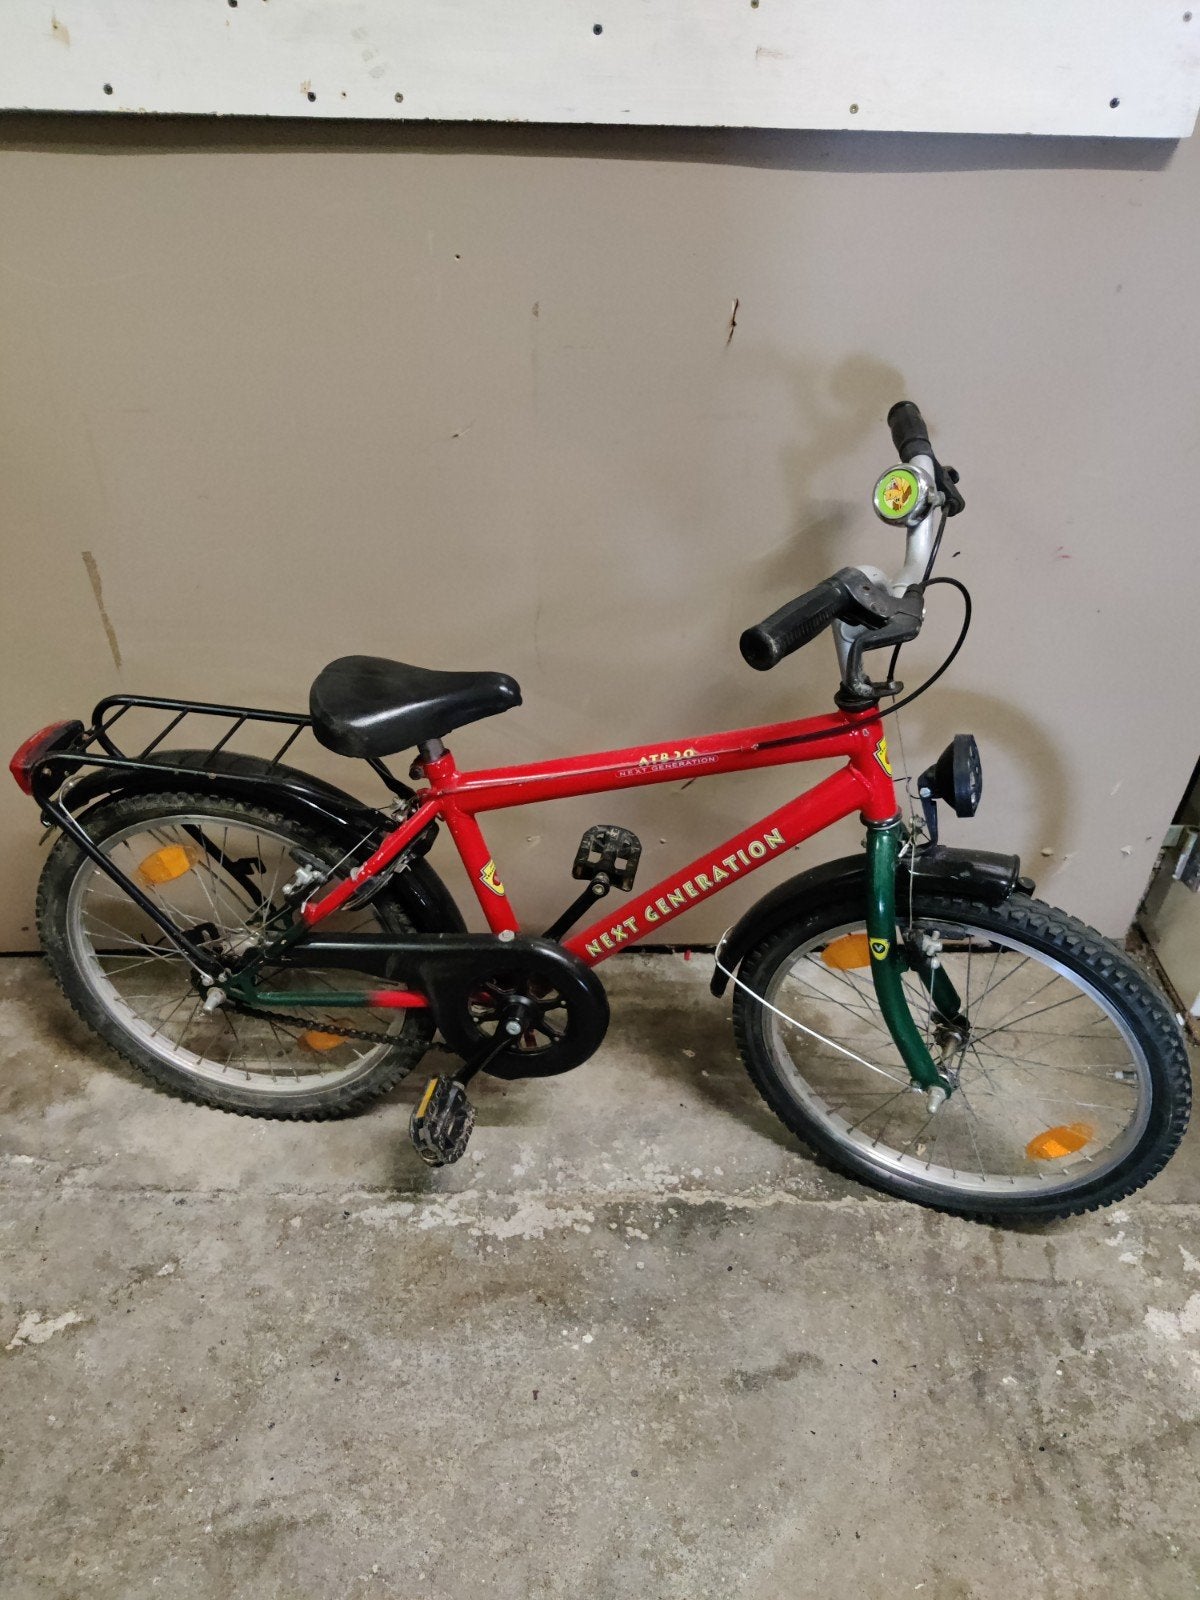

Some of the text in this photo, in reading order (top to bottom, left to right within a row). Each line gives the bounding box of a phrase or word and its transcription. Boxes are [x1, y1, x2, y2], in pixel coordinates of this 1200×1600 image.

[619, 757, 715, 777] NEXT GENERATION
[585, 828, 785, 957] NEXT GENERATION
